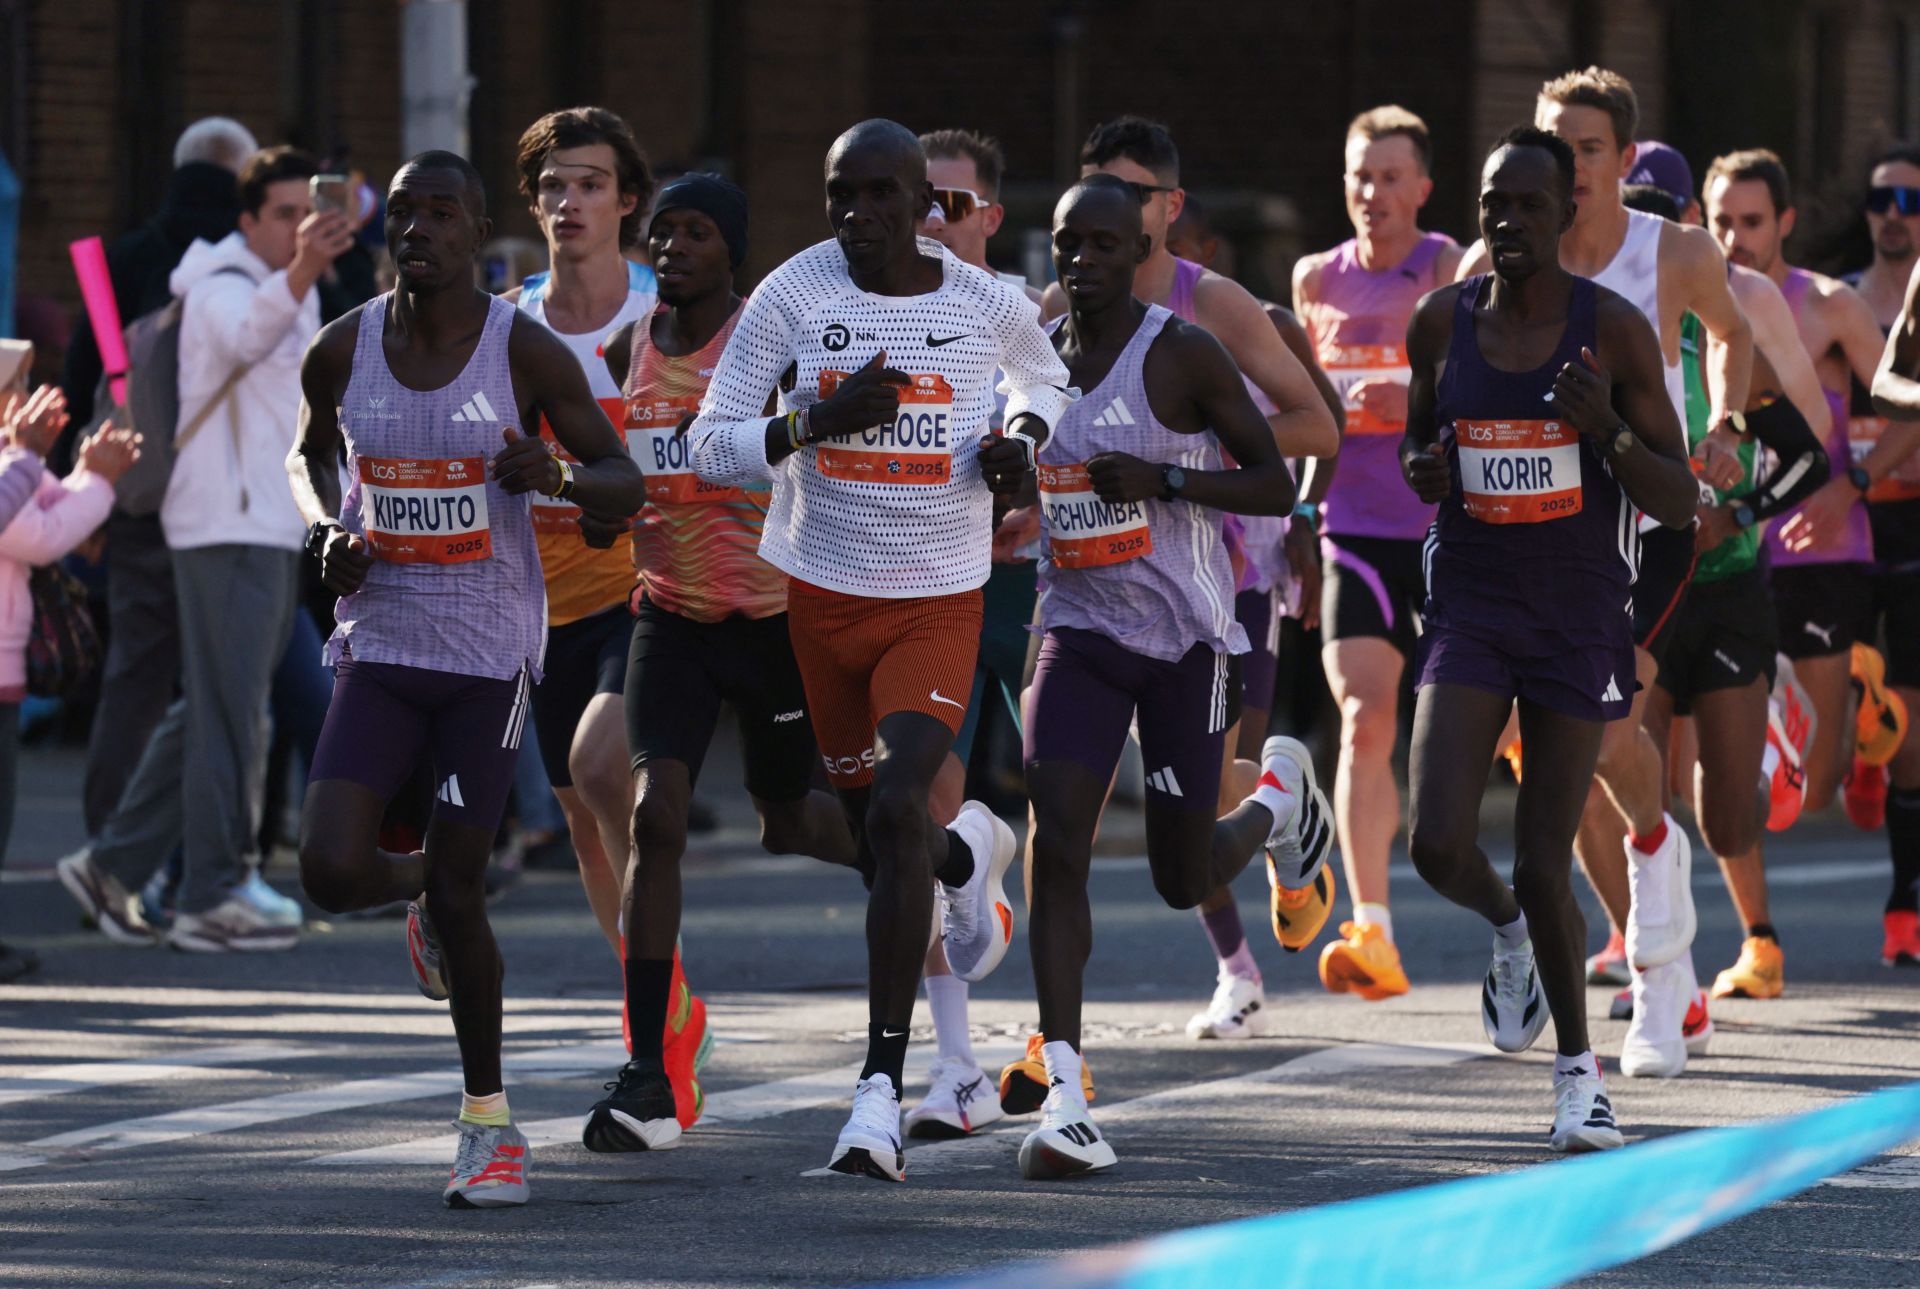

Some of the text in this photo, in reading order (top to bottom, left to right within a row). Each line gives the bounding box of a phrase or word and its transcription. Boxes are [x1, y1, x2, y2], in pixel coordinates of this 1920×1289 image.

[856, 332, 876, 342] NN
[915, 388, 937, 396] TATA
[632, 404, 653, 421] tcs
[1468, 424, 1493, 441] tcs
[371, 461, 396, 480] tcs
[446, 472, 468, 480] TATA
[905, 463, 943, 476] 2025
[1482, 456, 1554, 491] KORIR
[373, 493, 476, 531] KIPRUTO
[1540, 496, 1575, 512] 2025
[446, 539, 483, 555] 2025
[1109, 536, 1144, 555] 2025
[773, 709, 803, 723] HOKA
